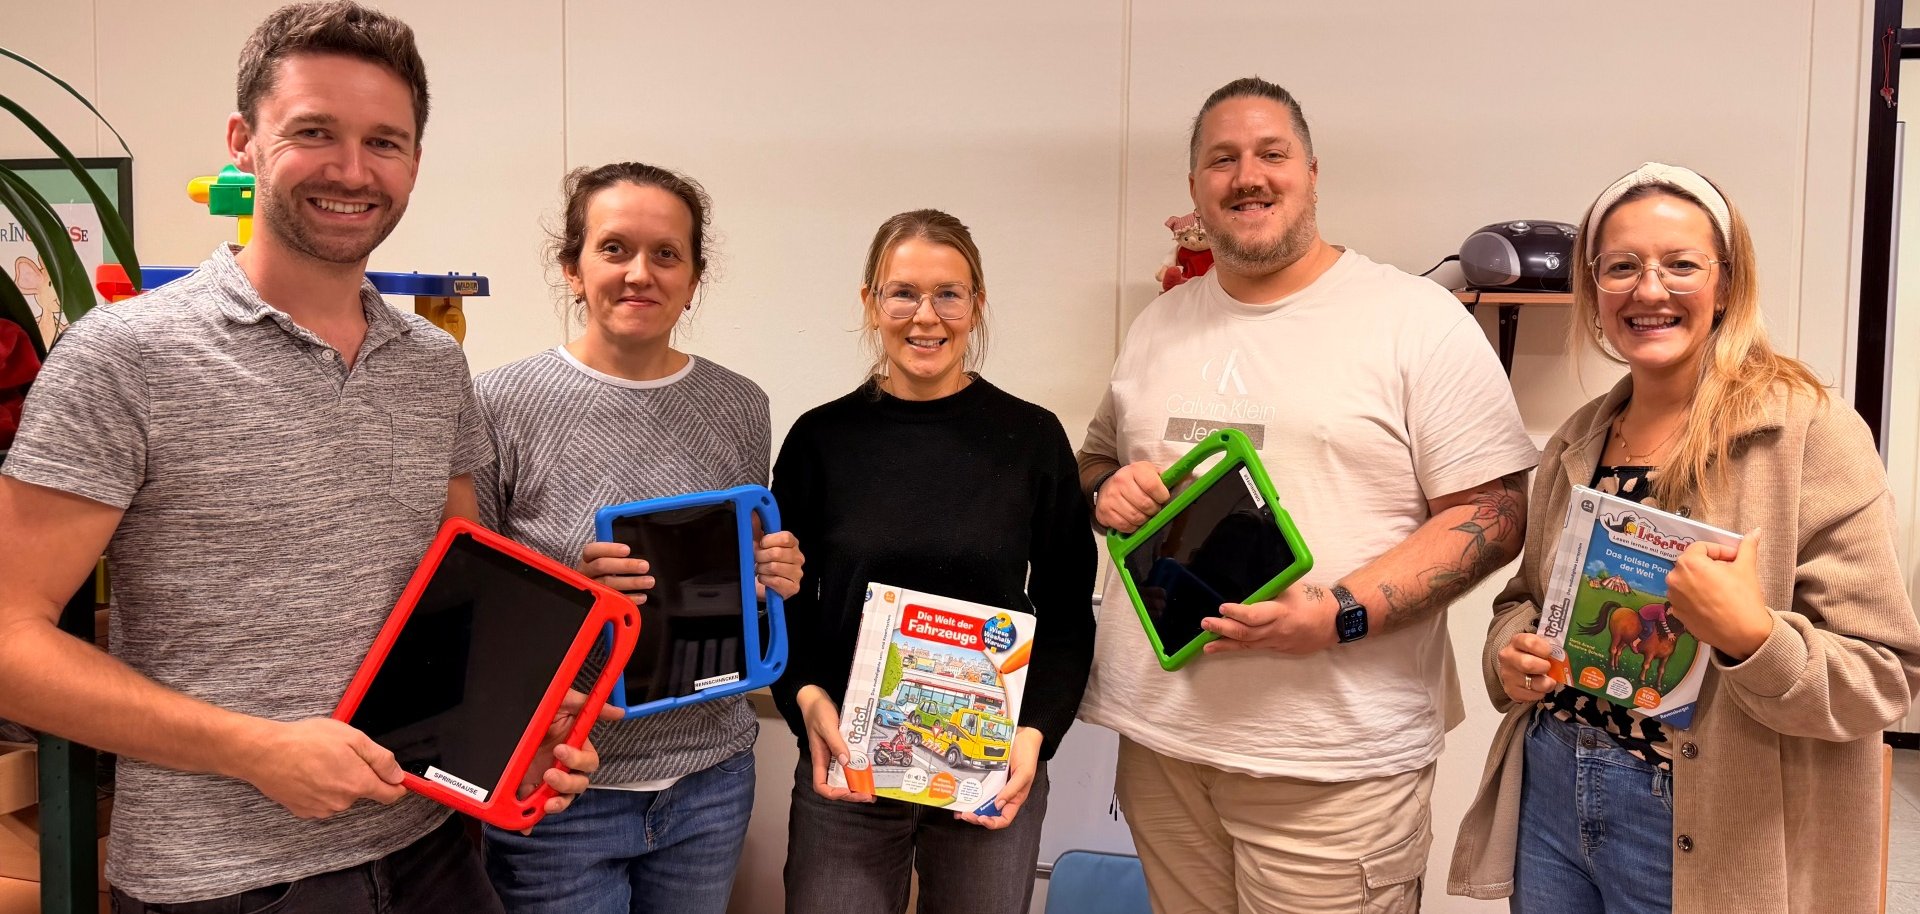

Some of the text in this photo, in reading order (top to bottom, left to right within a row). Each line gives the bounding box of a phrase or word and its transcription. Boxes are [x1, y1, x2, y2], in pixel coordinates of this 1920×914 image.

[1166, 393, 1276, 421] Calvin Klein
[1605, 548, 1622, 560] Das
[1623, 554, 1650, 569] tollste
[1620, 563, 1655, 579] der Welt
[917, 610, 974, 630] Die Welt der
[1544, 604, 1563, 637] tiptoi
[907, 618, 978, 646] Fahrzeuge
[989, 626, 1009, 637] Wieso
[984, 636, 1008, 650] Warum
[848, 706, 867, 744] tiptoi
